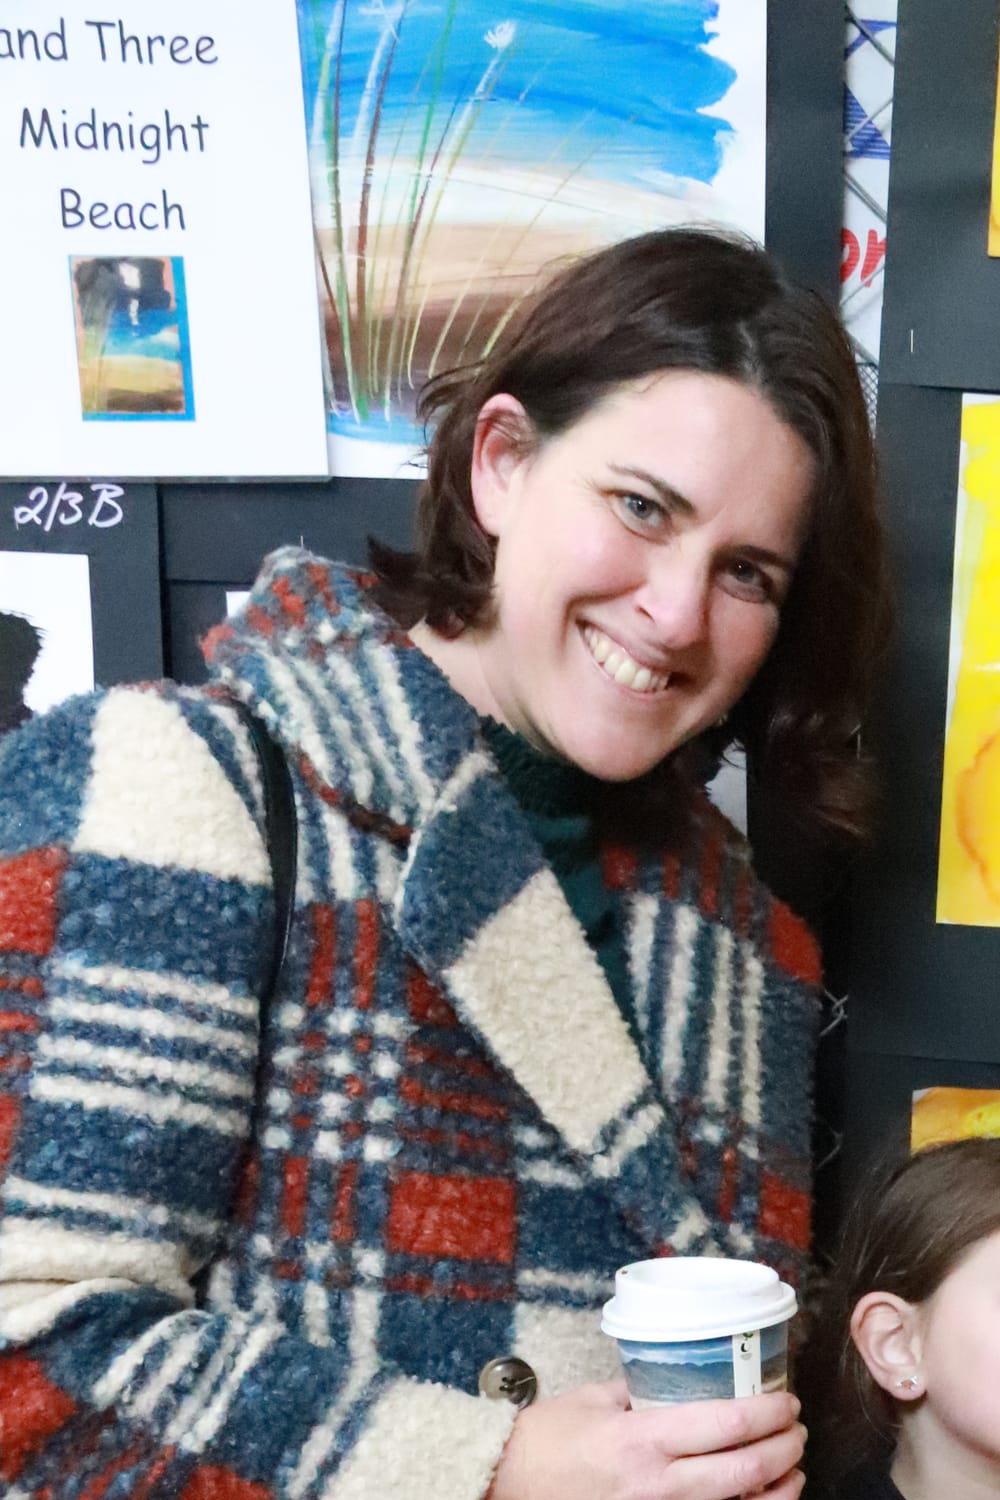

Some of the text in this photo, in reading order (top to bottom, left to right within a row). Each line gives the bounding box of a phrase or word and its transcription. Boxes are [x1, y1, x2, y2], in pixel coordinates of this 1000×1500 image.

[0, 17, 218, 64] and Three
[20, 107, 209, 164] Midnight
[60, 188, 186, 230] Beach
